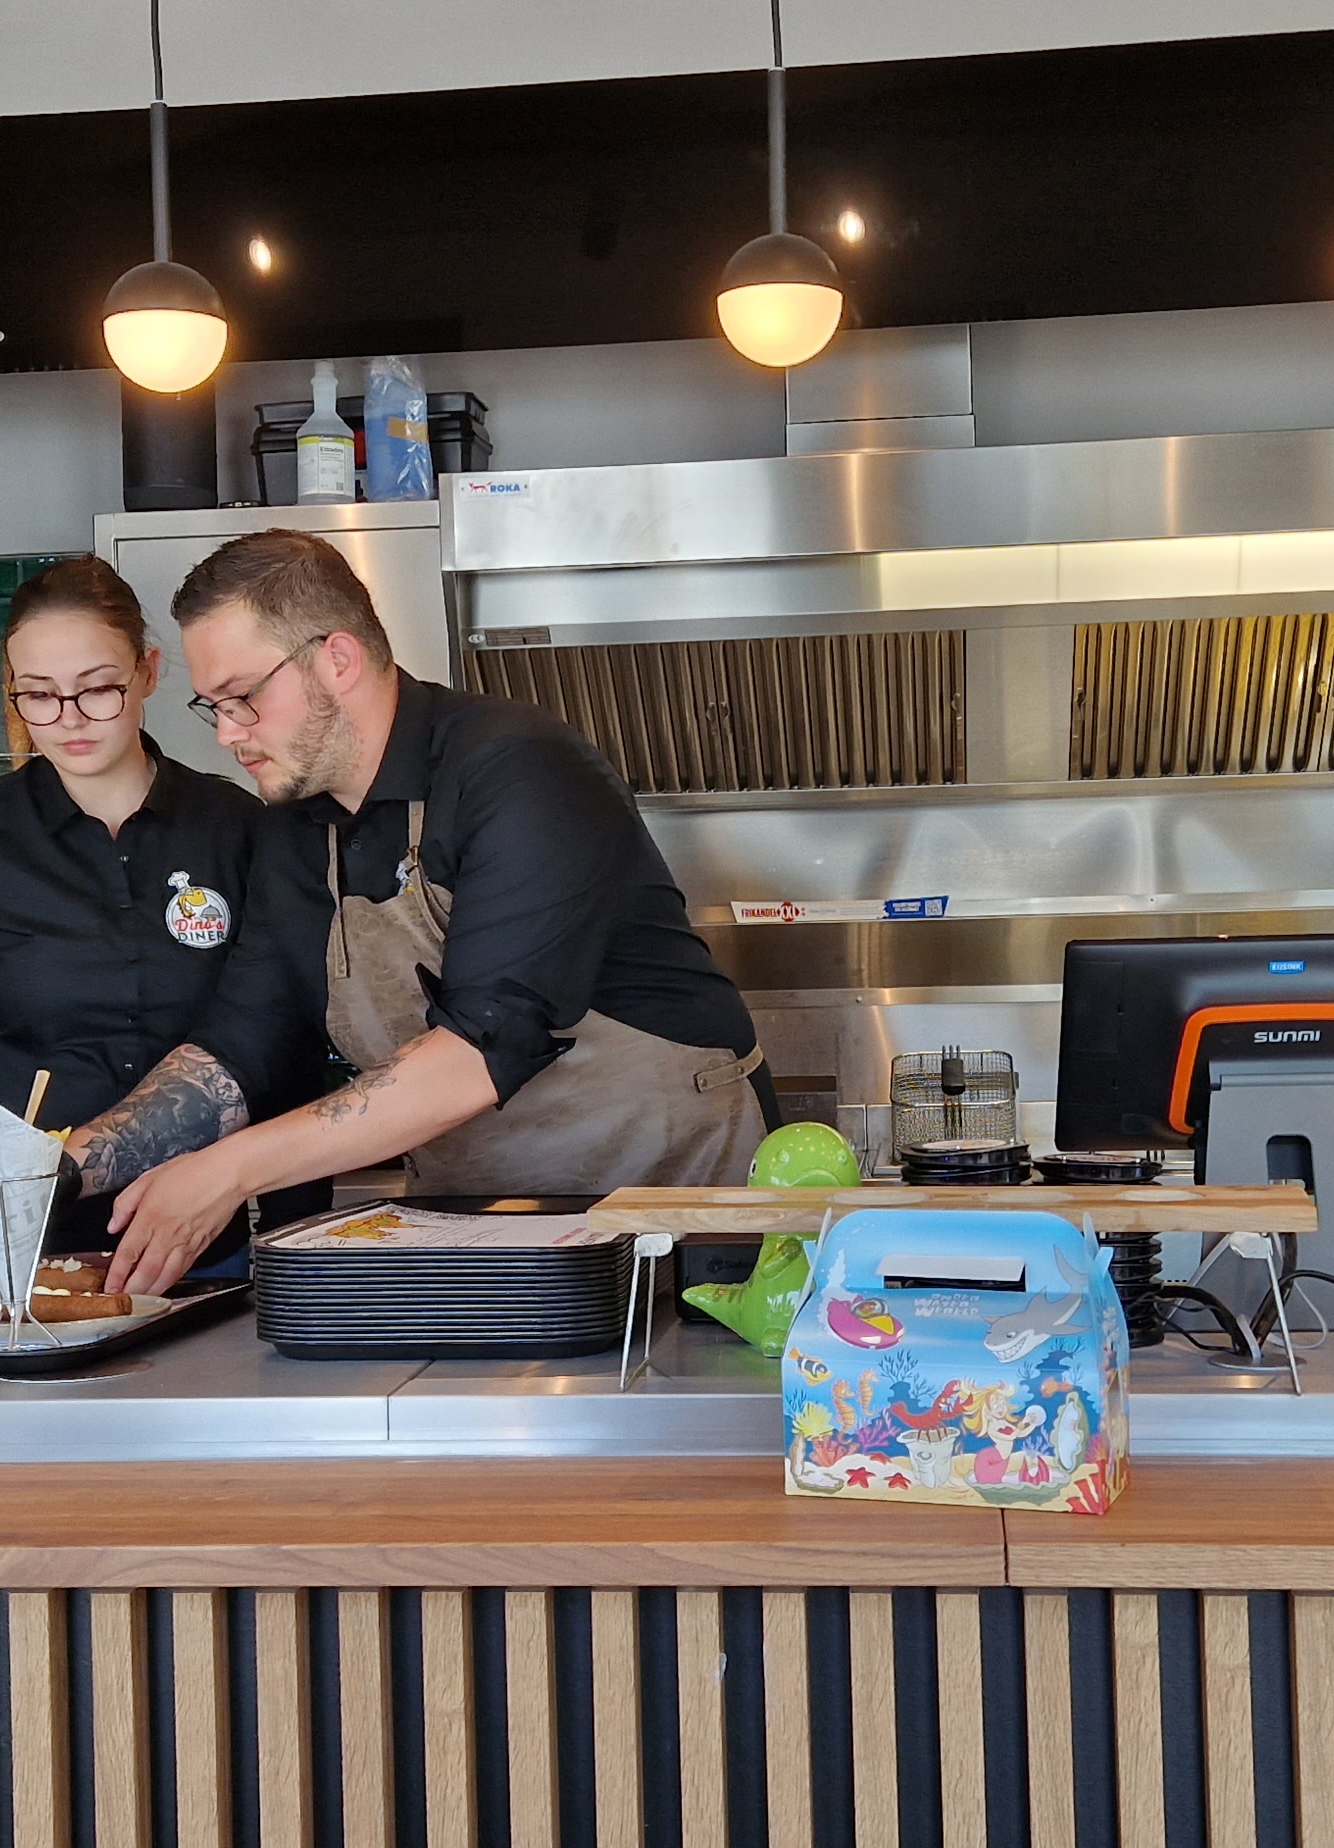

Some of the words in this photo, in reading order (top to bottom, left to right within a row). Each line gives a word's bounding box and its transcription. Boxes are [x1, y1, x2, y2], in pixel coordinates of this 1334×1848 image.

[490, 483, 521, 493] ROKA
[175, 917, 225, 932] Dino's
[178, 931, 225, 942] DINER
[1253, 1029, 1321, 1044] SUNMI
